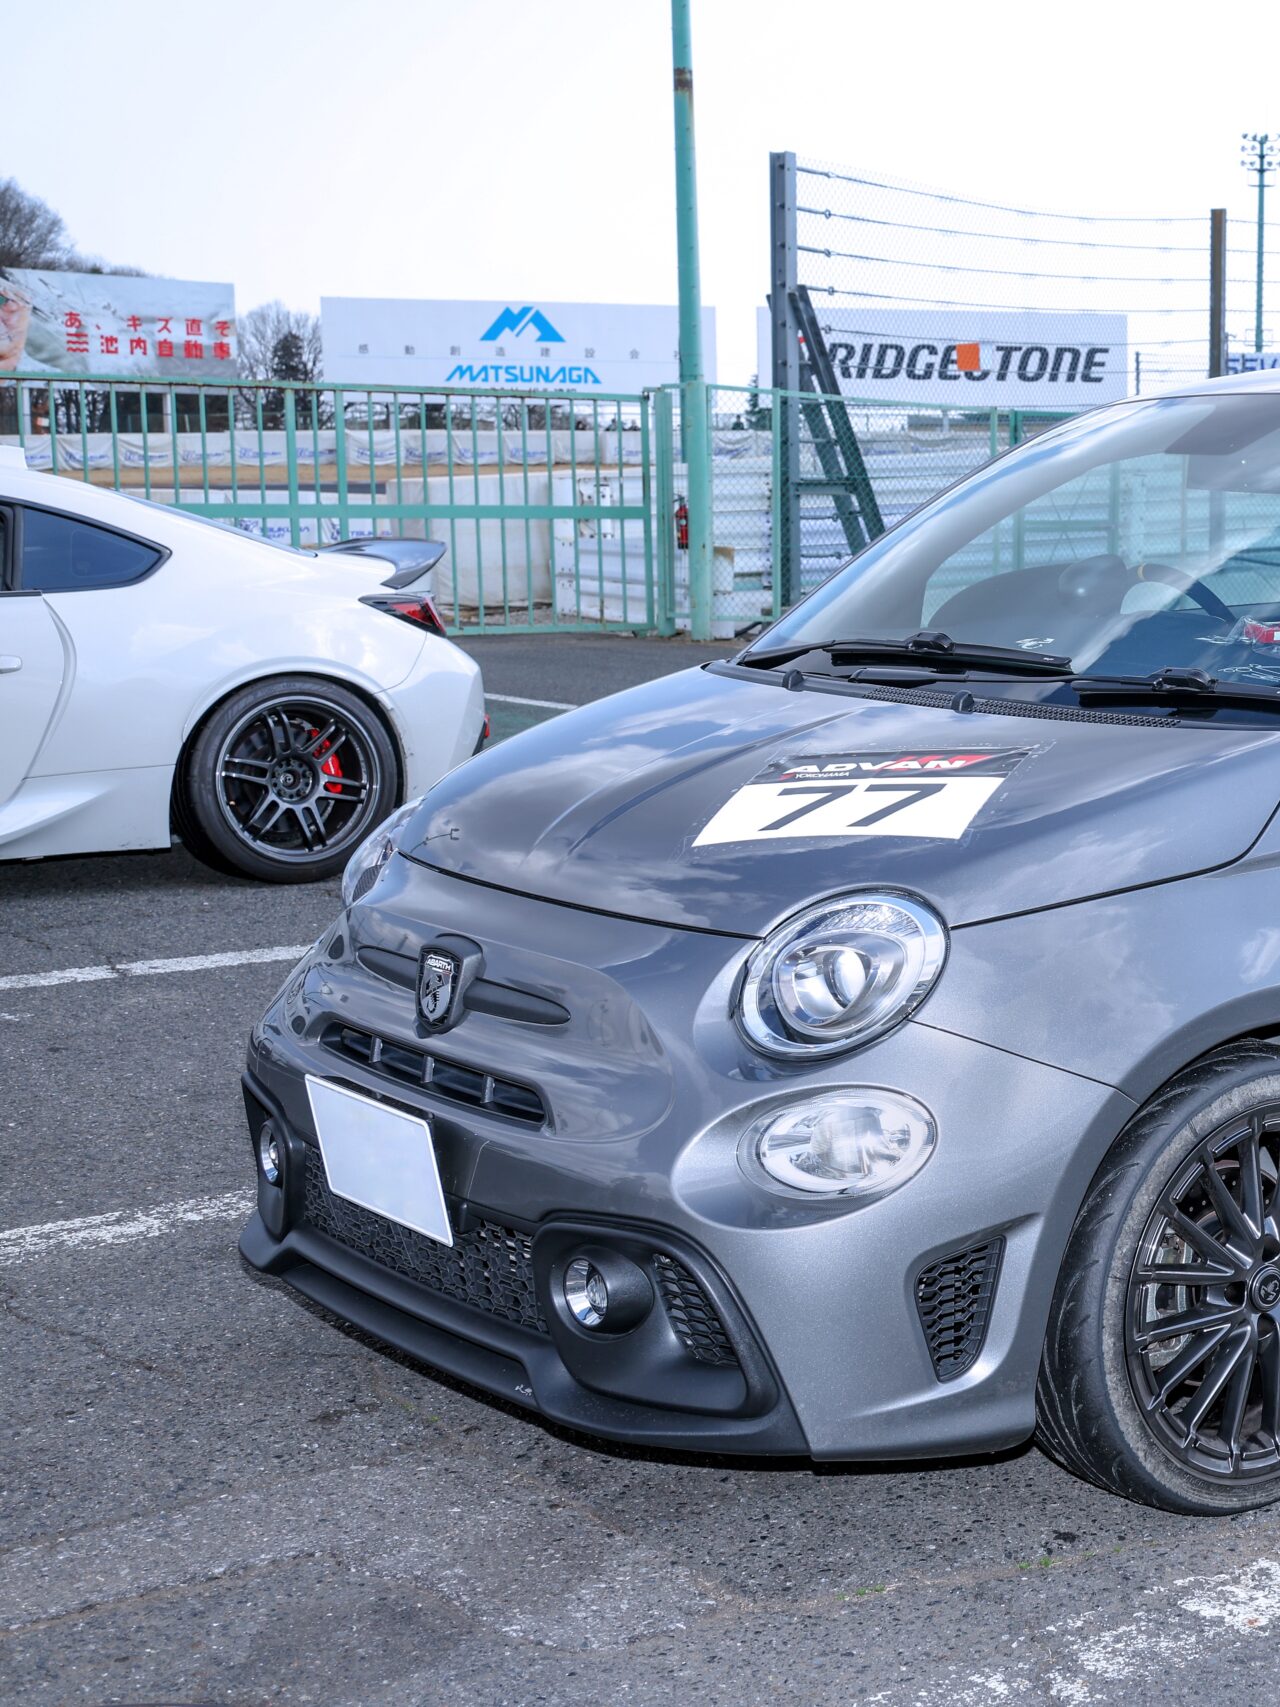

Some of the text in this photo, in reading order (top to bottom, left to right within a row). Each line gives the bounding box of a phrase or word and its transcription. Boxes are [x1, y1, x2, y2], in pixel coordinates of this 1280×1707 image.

[798, 337, 1110, 383] RIDGETONE
[445, 364, 602, 385] MATSUNAGA
[783, 760, 966, 774] ADVAN
[757, 783, 949, 832] 77
[427, 958, 451, 970] ABARTH
